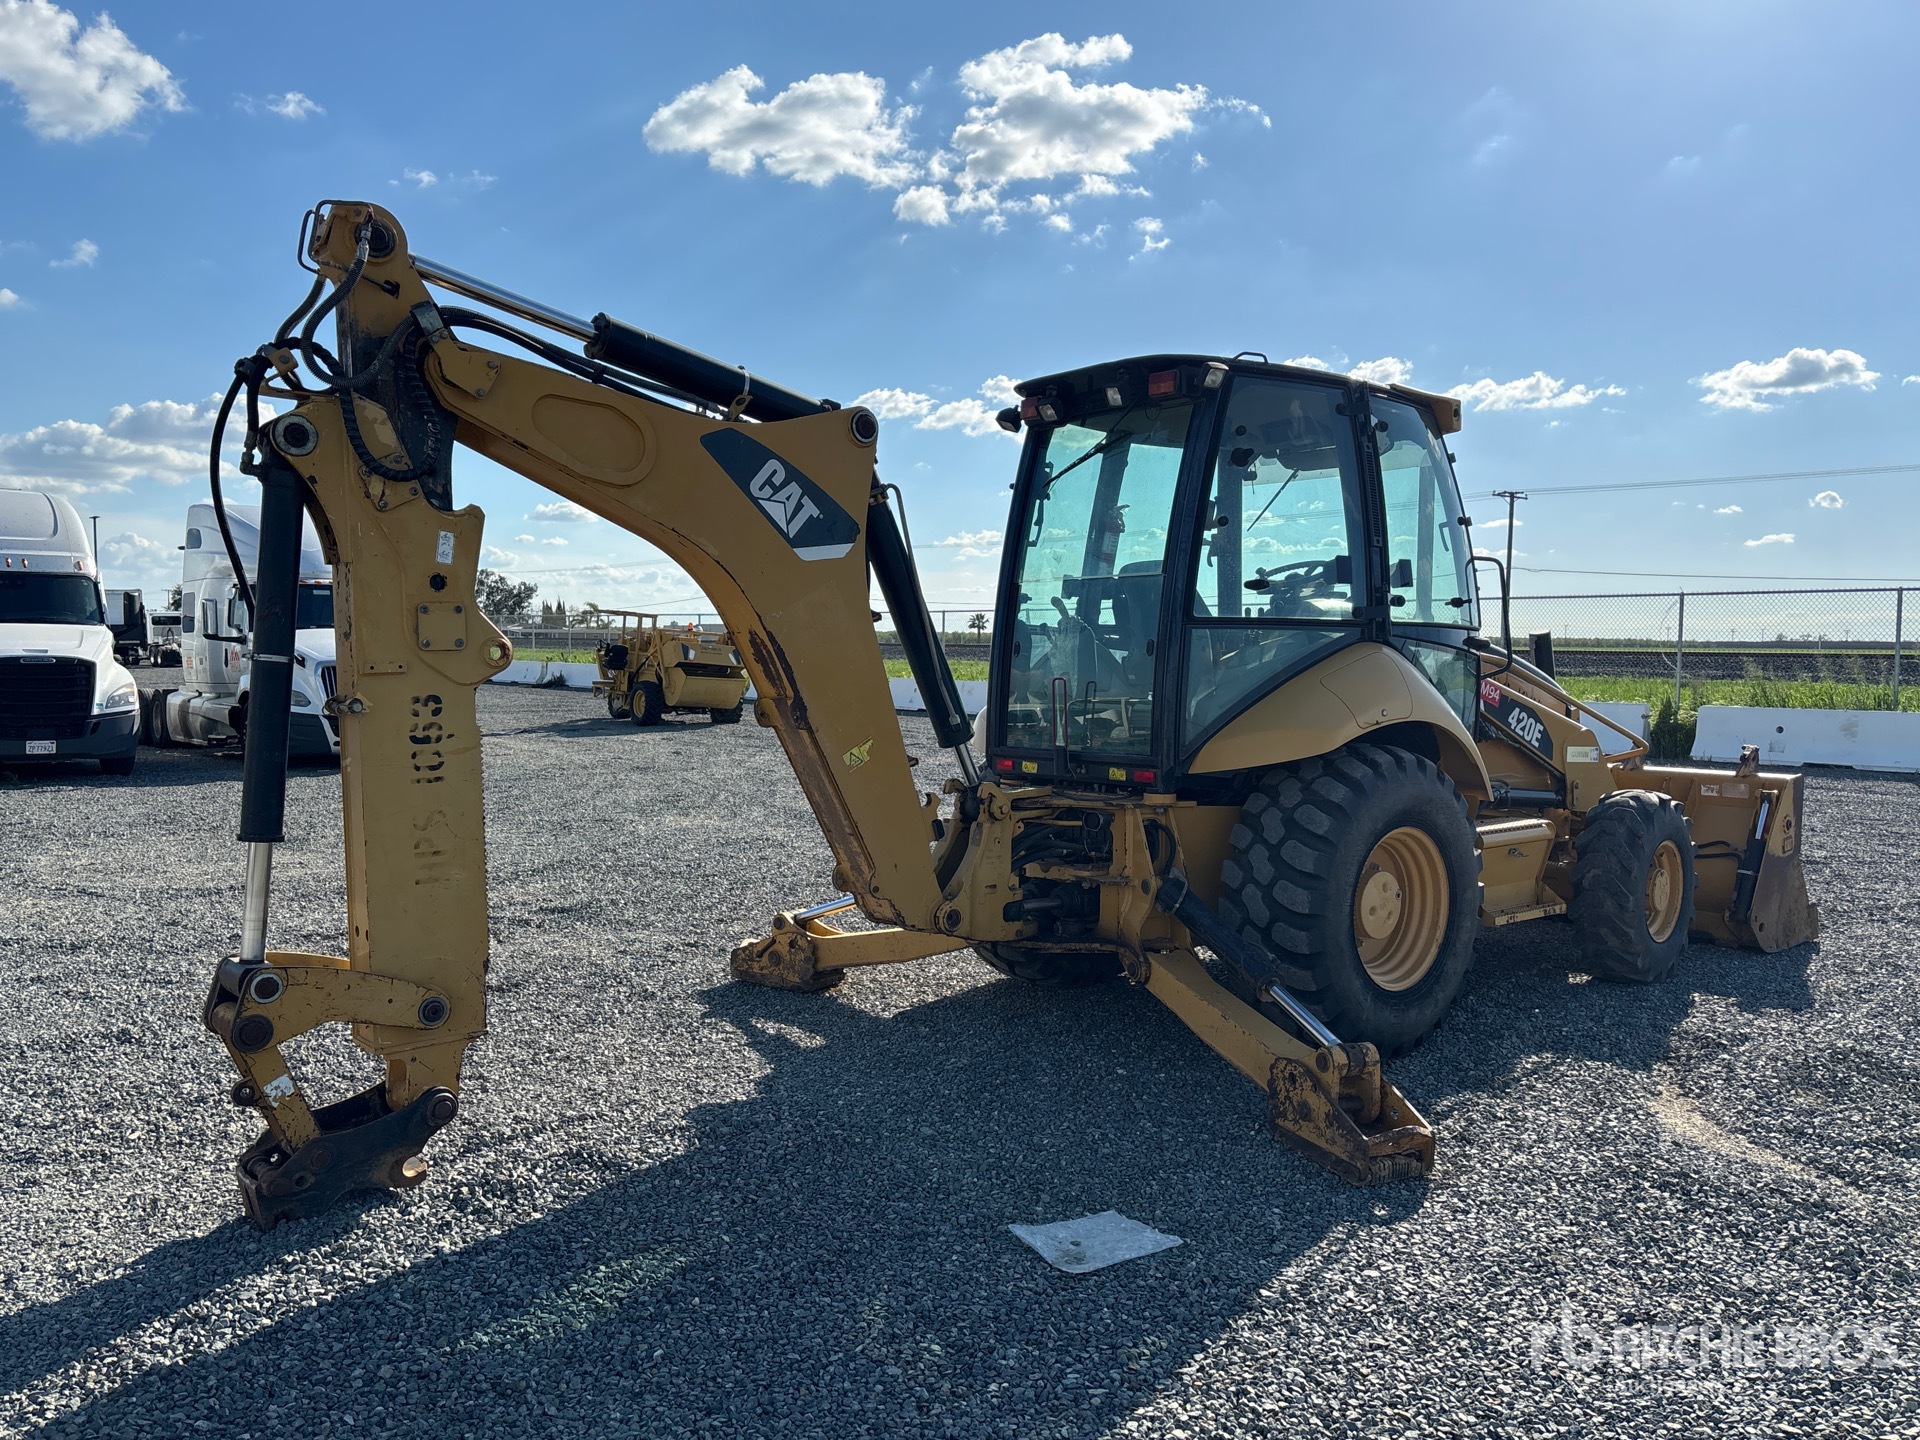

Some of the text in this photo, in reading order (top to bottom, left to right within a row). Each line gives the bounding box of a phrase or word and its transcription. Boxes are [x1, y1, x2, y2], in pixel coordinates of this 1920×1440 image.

[749, 458, 820, 539] CAT
[1481, 680, 1500, 703] M94
[409, 694, 445, 785] 1063
[1508, 706, 1544, 748] 420E
